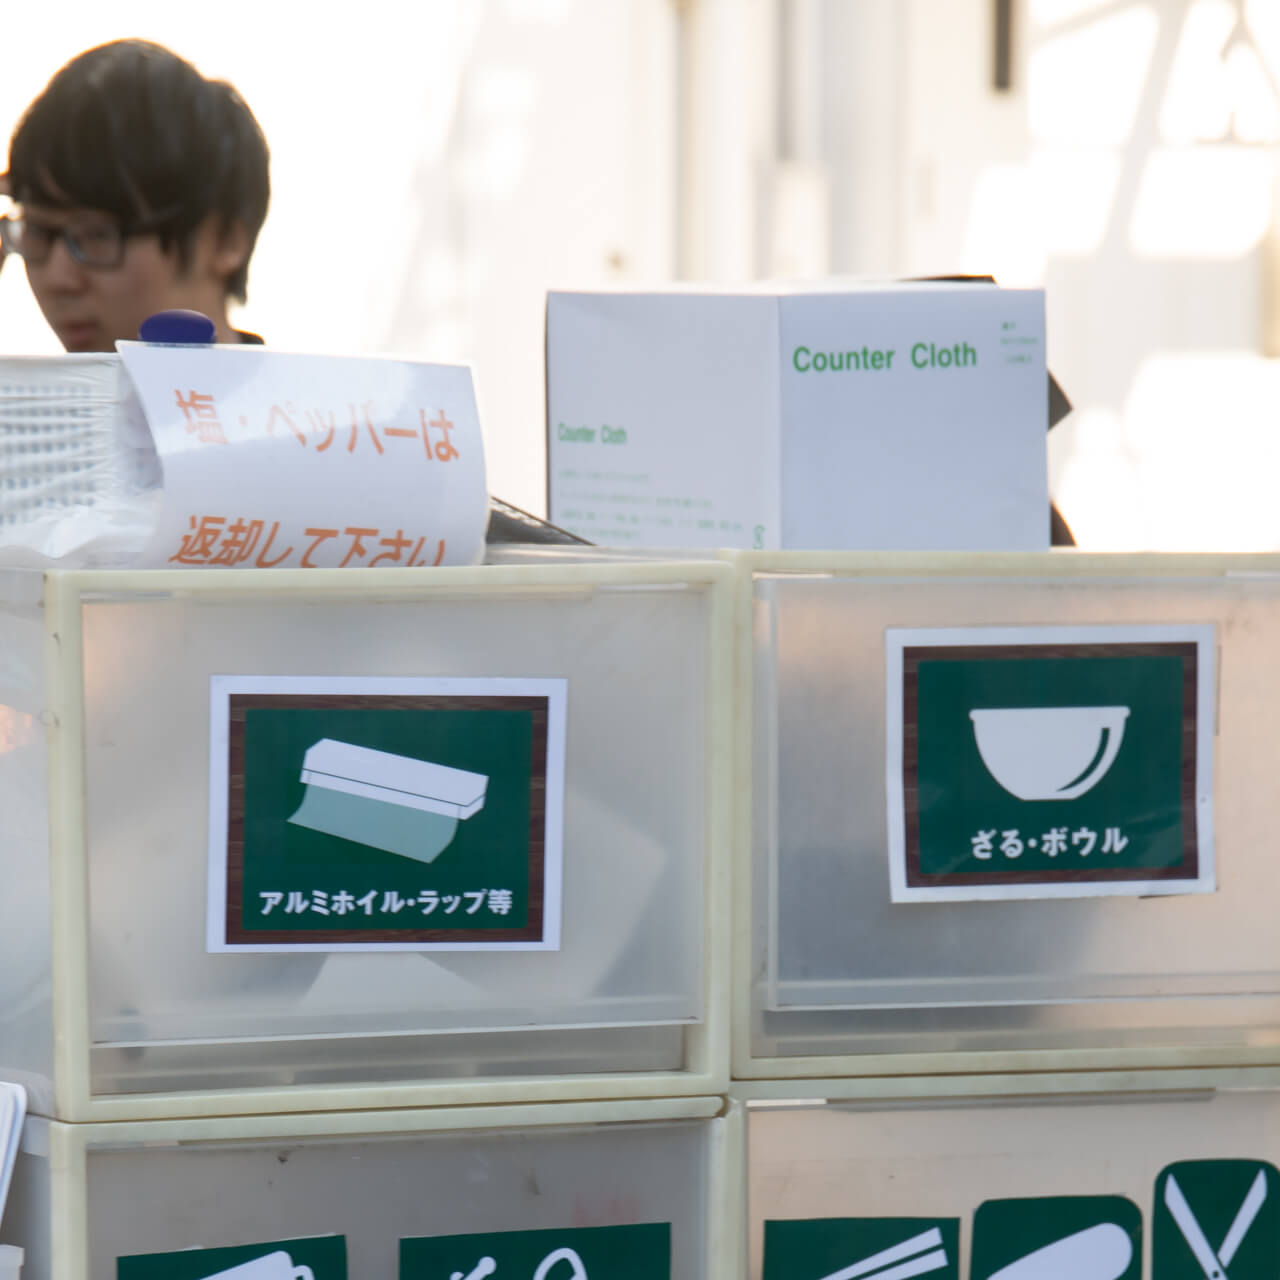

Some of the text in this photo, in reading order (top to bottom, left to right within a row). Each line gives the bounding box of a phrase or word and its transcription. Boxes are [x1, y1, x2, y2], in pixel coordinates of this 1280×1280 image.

[793, 345, 895, 373] Counter
[911, 341, 977, 369] Cloth
[558, 422, 628, 445] Counter Cloth
[168, 514, 446, 568] 返却して下さい
[970, 827, 1129, 860] ざる・ボウル
[259, 889, 513, 916] アルミホイル・ラップ等
